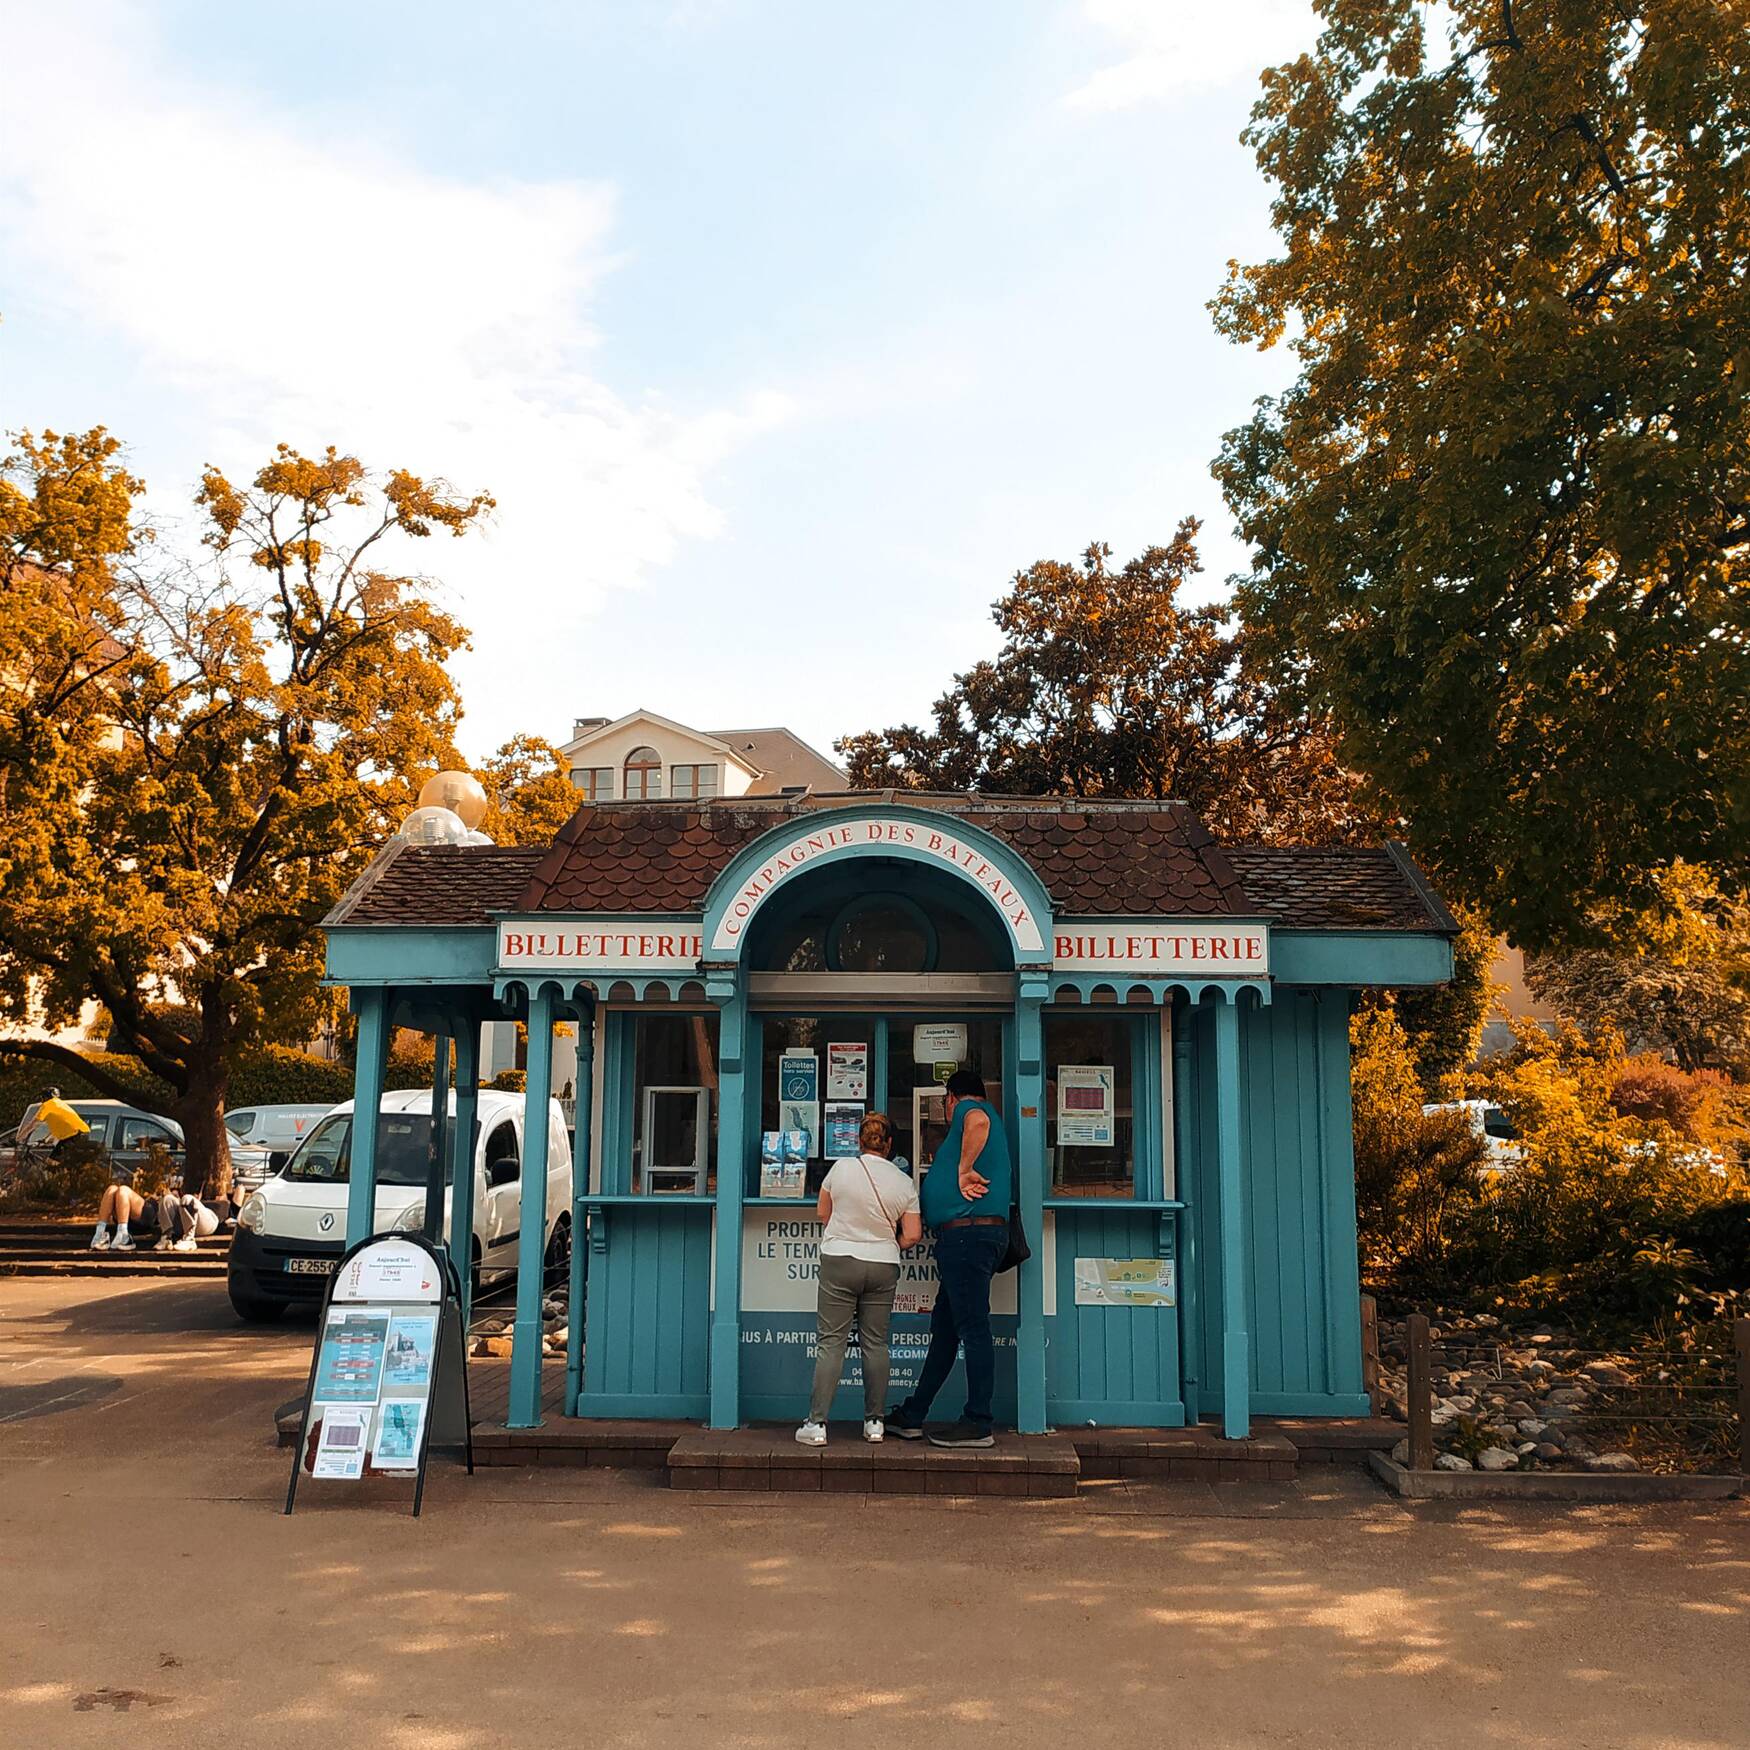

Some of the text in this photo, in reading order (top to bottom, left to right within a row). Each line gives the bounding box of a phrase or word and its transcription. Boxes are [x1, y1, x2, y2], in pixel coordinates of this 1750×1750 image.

[724, 824, 1029, 936] COMPAGNIE DES BATEAUX
[505, 934, 703, 957] BILLETTERIE
[1054, 936, 1263, 960] BILLETTERIE
[783, 1061, 815, 1069] Toilettes
[767, 1221, 824, 1238] PROFIT
[758, 1242, 776, 1259] LE
[782, 1242, 818, 1259] TEM
[787, 1263, 821, 1280] SUR
[764, 1328, 773, 1344] À
[776, 1331, 817, 1344] PARTIR
[892, 1333, 933, 1345] PERSO
[901, 1367, 913, 1377] 40
